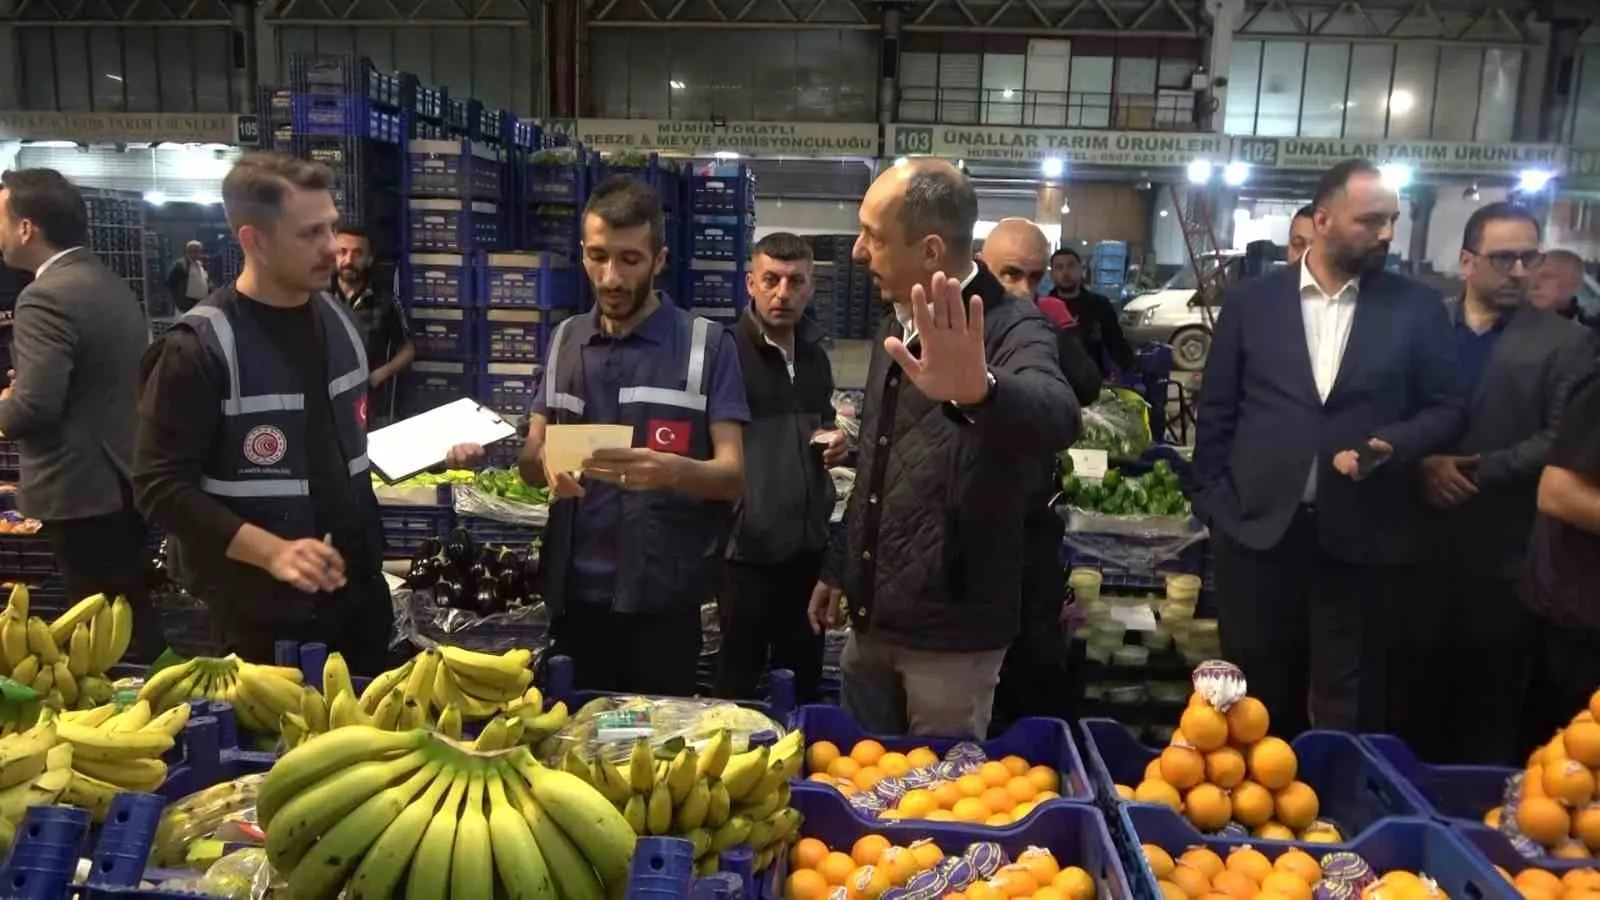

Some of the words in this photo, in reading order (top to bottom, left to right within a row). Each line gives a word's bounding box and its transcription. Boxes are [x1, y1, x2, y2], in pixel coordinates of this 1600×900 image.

[240, 121, 258, 137] 105
[583, 133, 635, 145] SEBZE
[657, 134, 711, 147] MEYVE
[717, 134, 872, 150] KOMİSYONCULUĞU
[897, 131, 929, 150] 103
[943, 128, 1038, 148] ÜNALLAR
[1046, 134, 1109, 150] TARIM
[1116, 133, 1220, 153] ÜRÜNLERİ
[1284, 138, 1379, 158] ÜNALLAR
[1386, 144, 1447, 159] TARIM
[1455, 142, 1558, 162] ÜRÜNLERİ
[1242, 143, 1274, 162] 102
